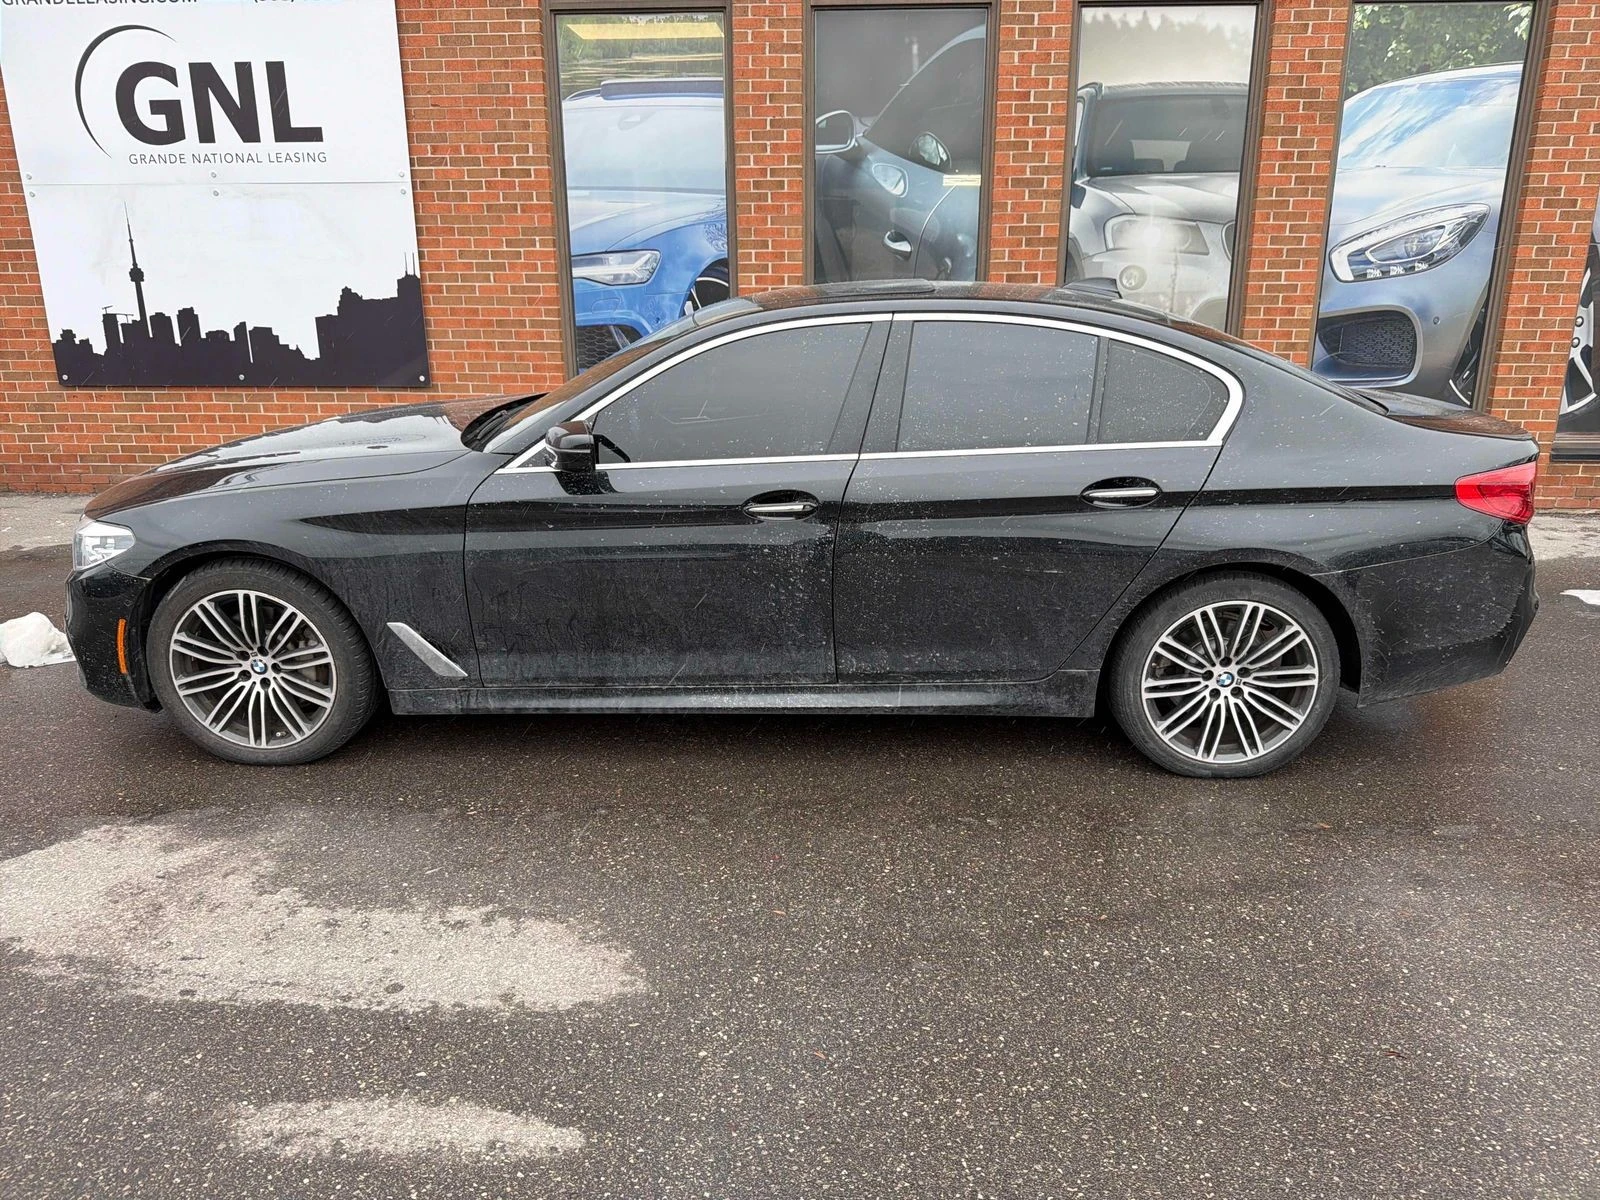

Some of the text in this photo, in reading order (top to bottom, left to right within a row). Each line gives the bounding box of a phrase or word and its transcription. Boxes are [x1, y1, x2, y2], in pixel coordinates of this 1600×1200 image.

[116, 60, 324, 146] GNL
[128, 151, 328, 165] GRANDE NATIONAL LEASING
